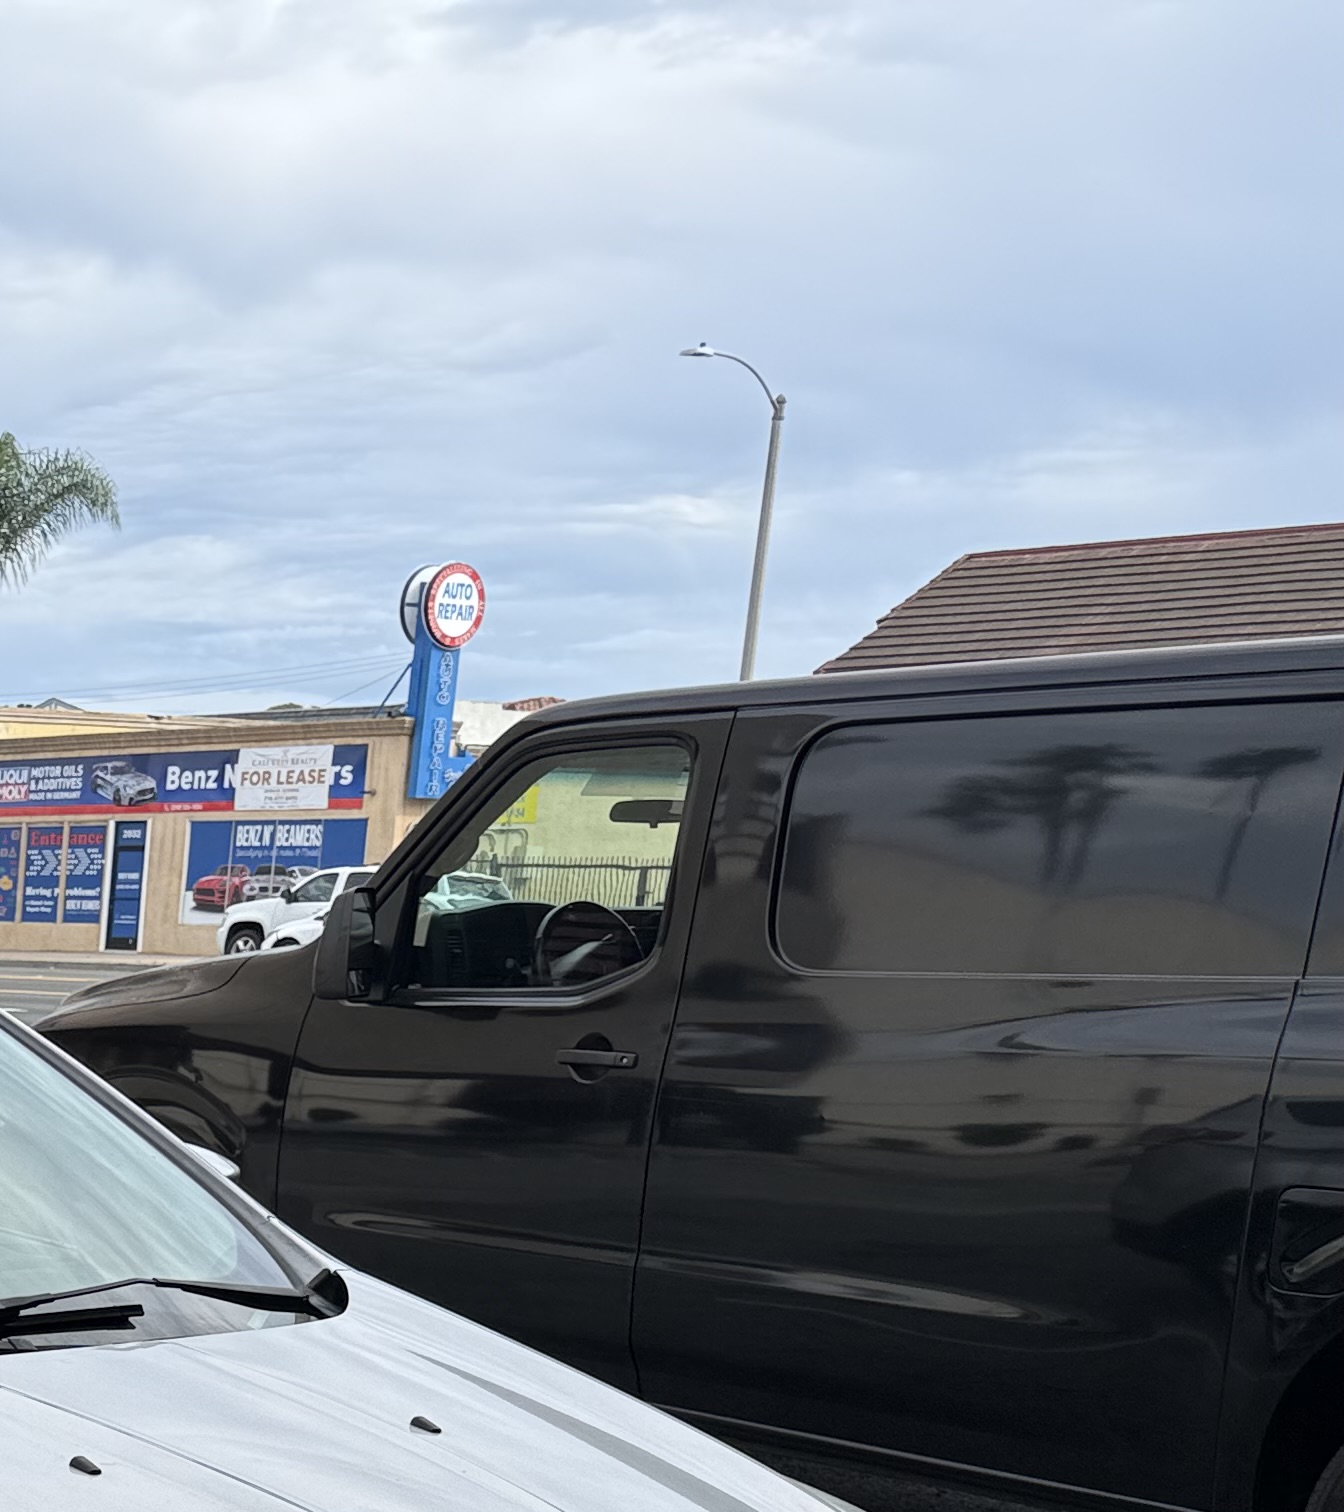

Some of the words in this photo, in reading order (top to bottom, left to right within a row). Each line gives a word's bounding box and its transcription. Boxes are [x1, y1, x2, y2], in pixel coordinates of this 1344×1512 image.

[442, 582, 473, 600] AUTO
[437, 603, 474, 620] REPAIR
[437, 652, 453, 705] AUTO
[427, 718, 447, 795] REPAIR
[30, 766, 61, 778] MOTOR
[63, 765, 84, 777] OILS
[165, 765, 219, 790] Benz
[240, 771, 272, 786] FOR
[276, 769, 327, 785] LEASE
[37, 778, 83, 790] ADDITIVES
[236, 825, 262, 847] BENZ
[276, 824, 323, 847] BEAMERS
